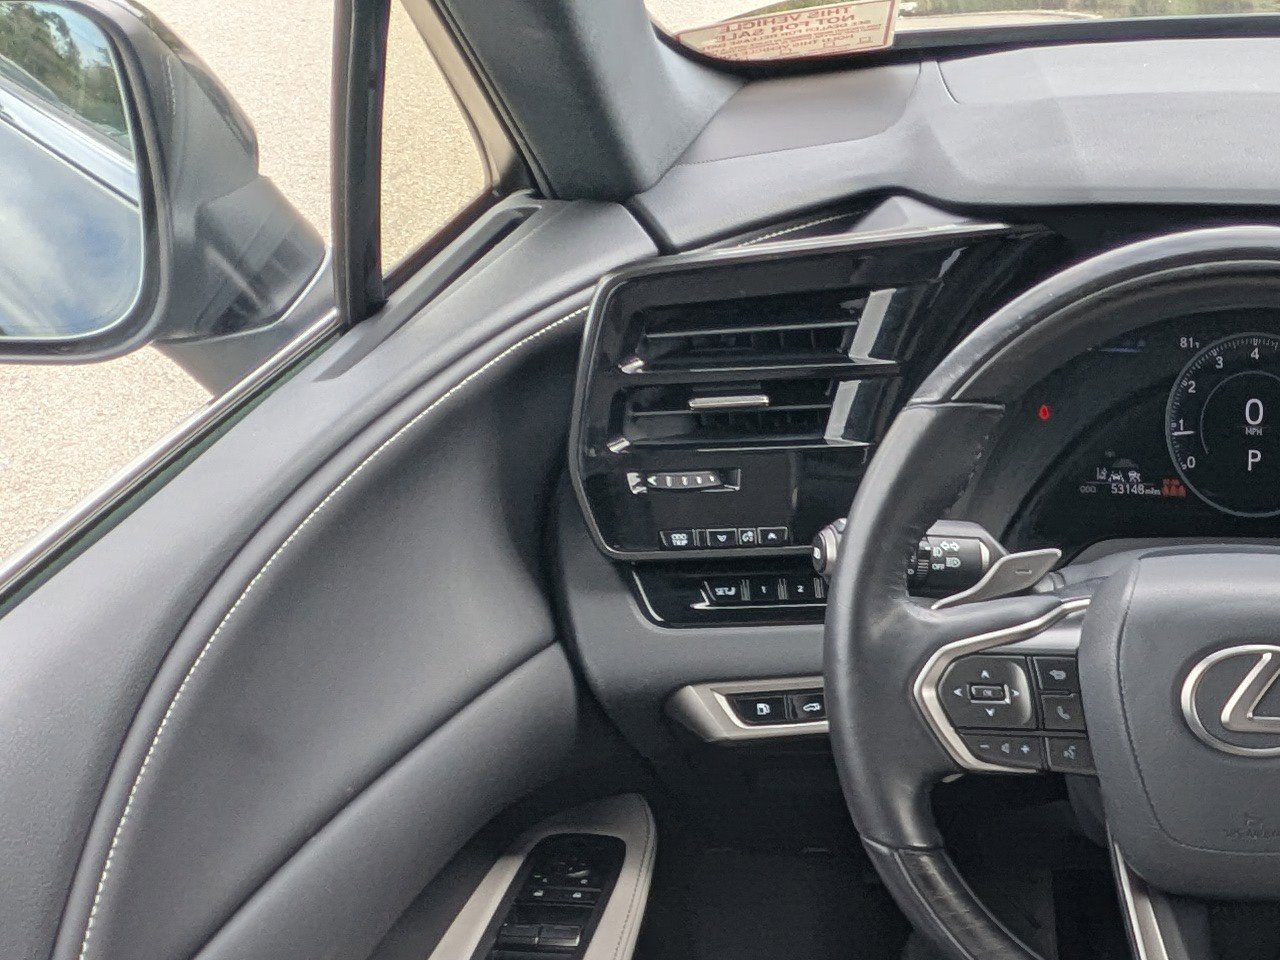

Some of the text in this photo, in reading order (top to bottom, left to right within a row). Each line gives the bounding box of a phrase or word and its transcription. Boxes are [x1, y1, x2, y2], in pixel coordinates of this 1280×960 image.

[1250, 348, 1260, 359] 4
[1215, 356, 1224, 369] 3
[1187, 381, 1196, 393] 2
[1245, 398, 1264, 425] 0
[1178, 418, 1185, 430] 1
[1187, 456, 1196, 468] 0
[1248, 450, 1262, 471] P
[1111, 483, 1145, 494] 53148
